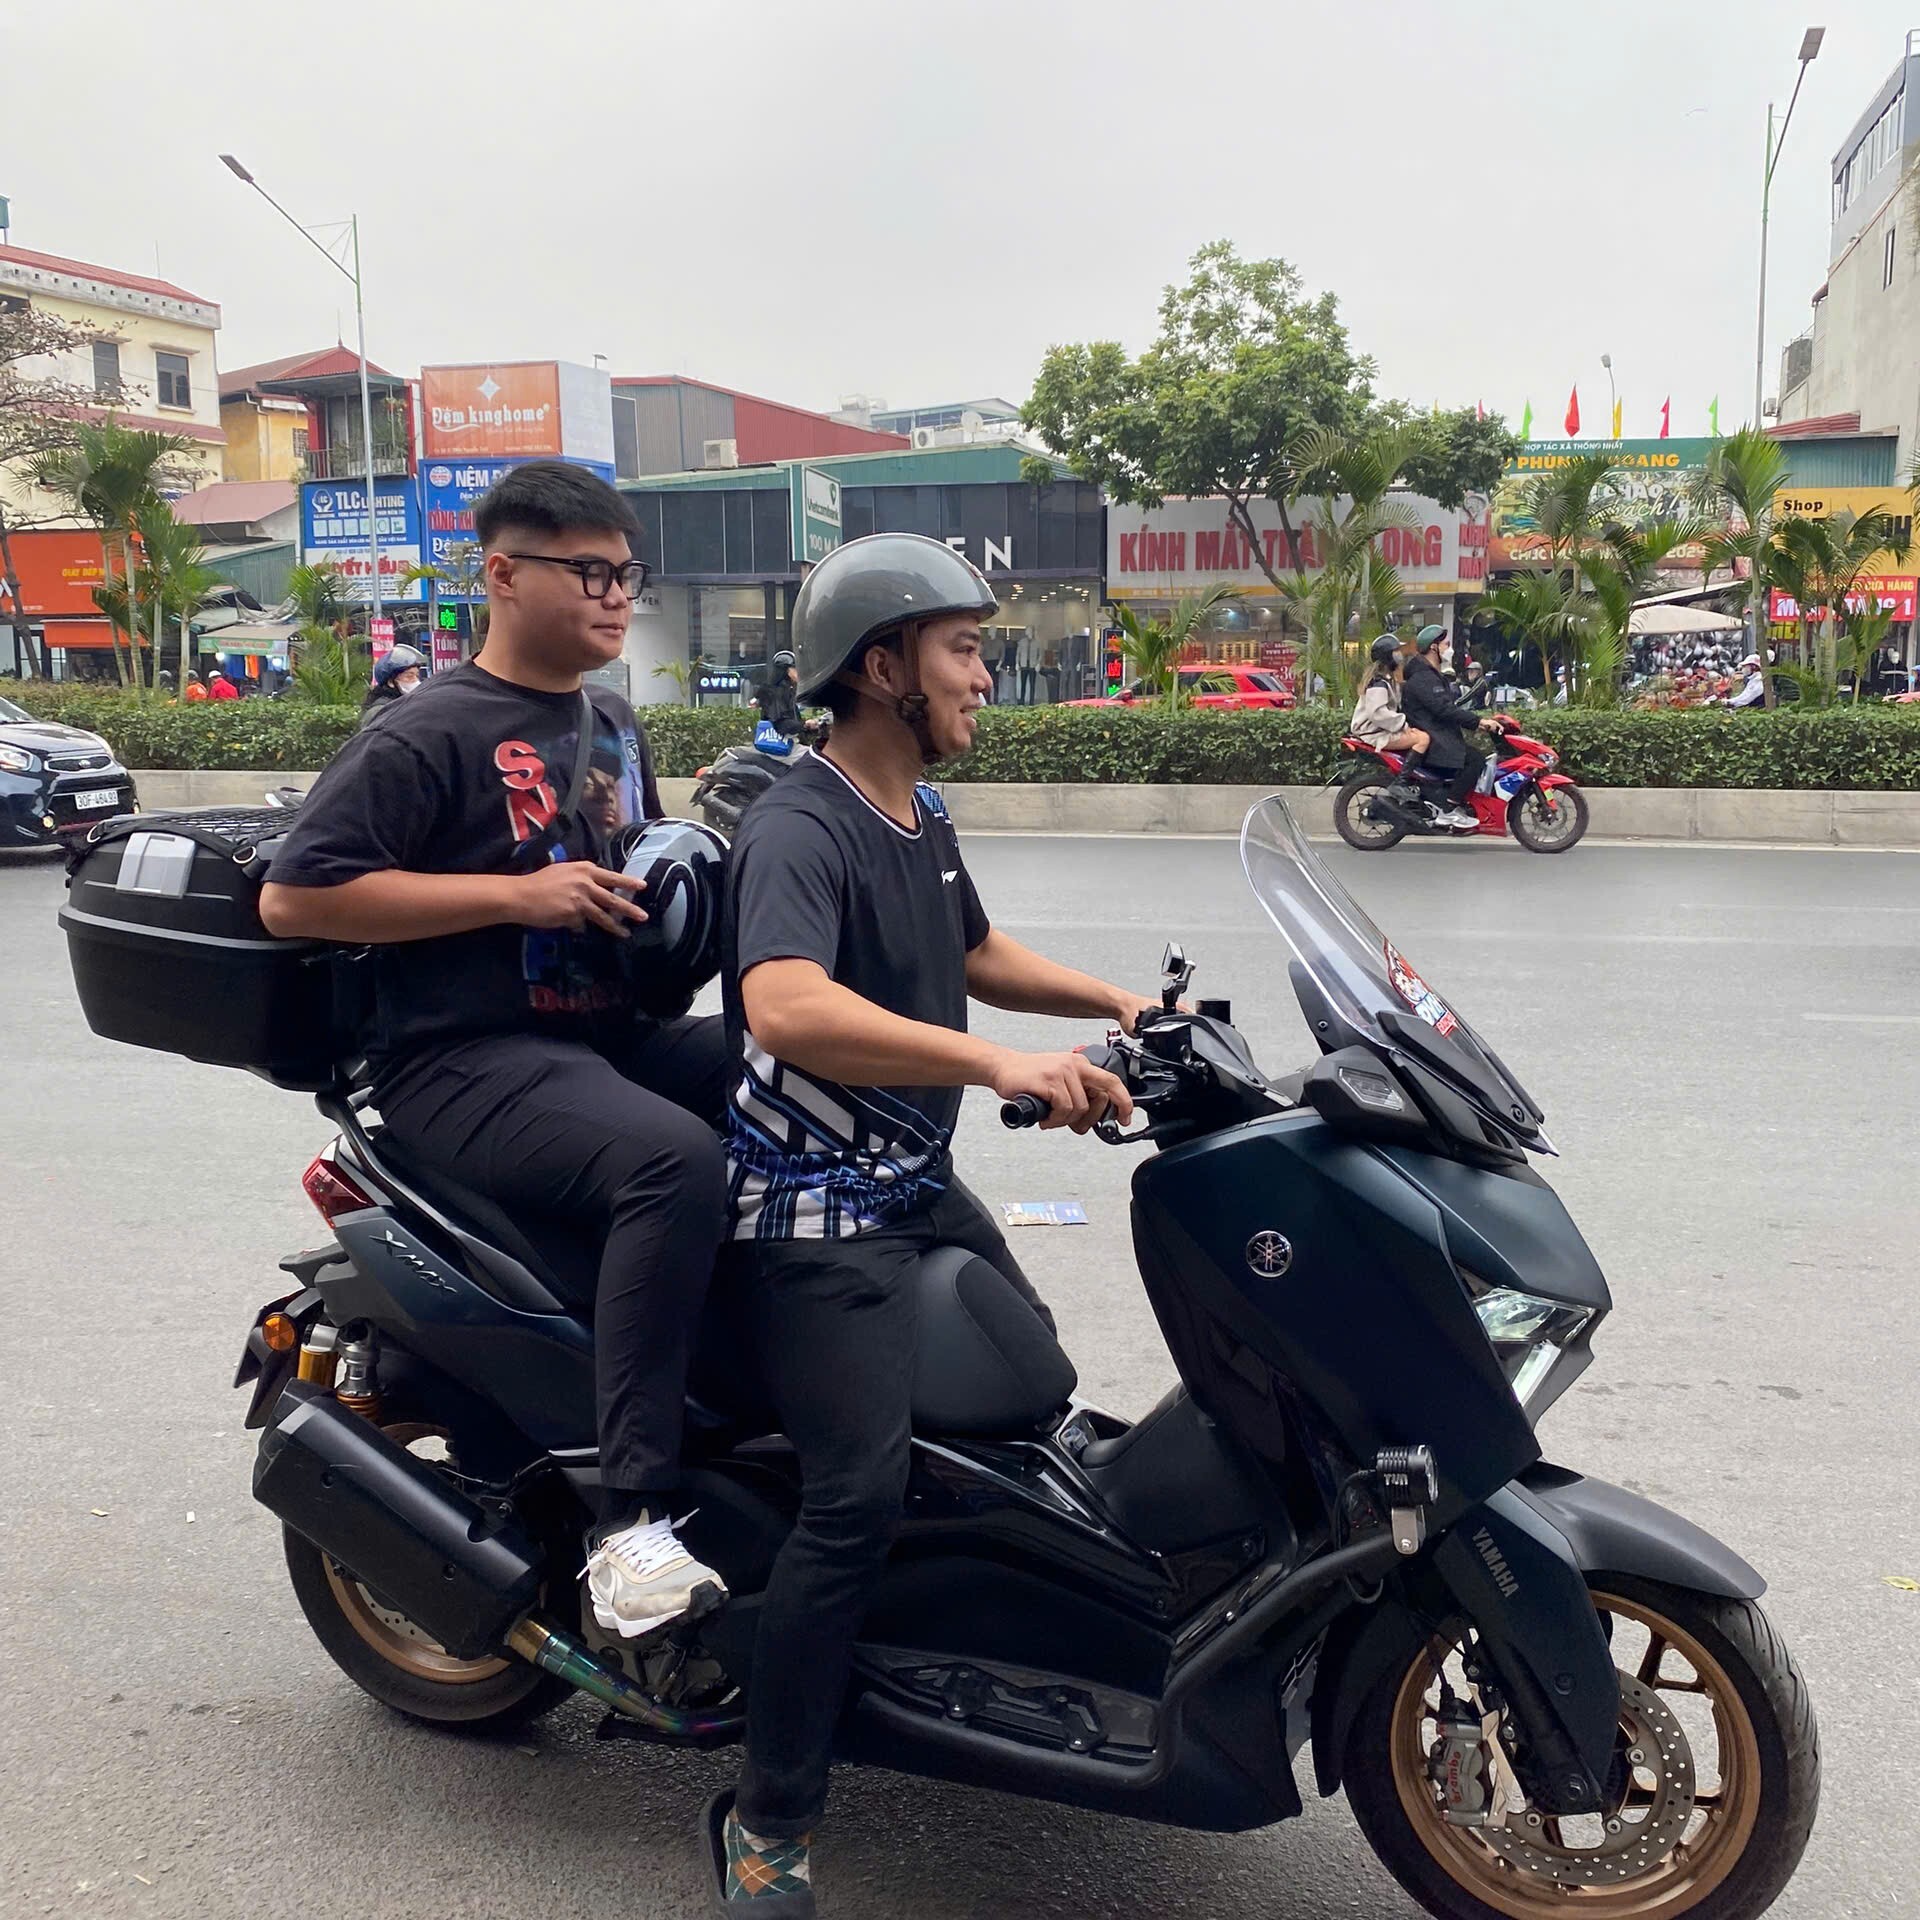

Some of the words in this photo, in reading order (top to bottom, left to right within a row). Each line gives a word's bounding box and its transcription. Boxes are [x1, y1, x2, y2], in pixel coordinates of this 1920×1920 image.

[432, 404, 465, 428] Đệm
[455, 465, 489, 492] NỆM
[335, 491, 360, 510] TLC
[807, 498, 840, 521] Vietcombank
[1783, 499, 1824, 513] Shop
[809, 533, 823, 552] 100
[824, 537, 832, 553] M
[1119, 523, 1186, 573] KÍNH
[1903, 598, 1913, 616] 1
[436, 634, 458, 651] TỔNG
[700, 676, 738, 688] OWEN
[1472, 1525, 1520, 1598] YAMAHA
[1446, 1750, 1462, 1804] brembo
